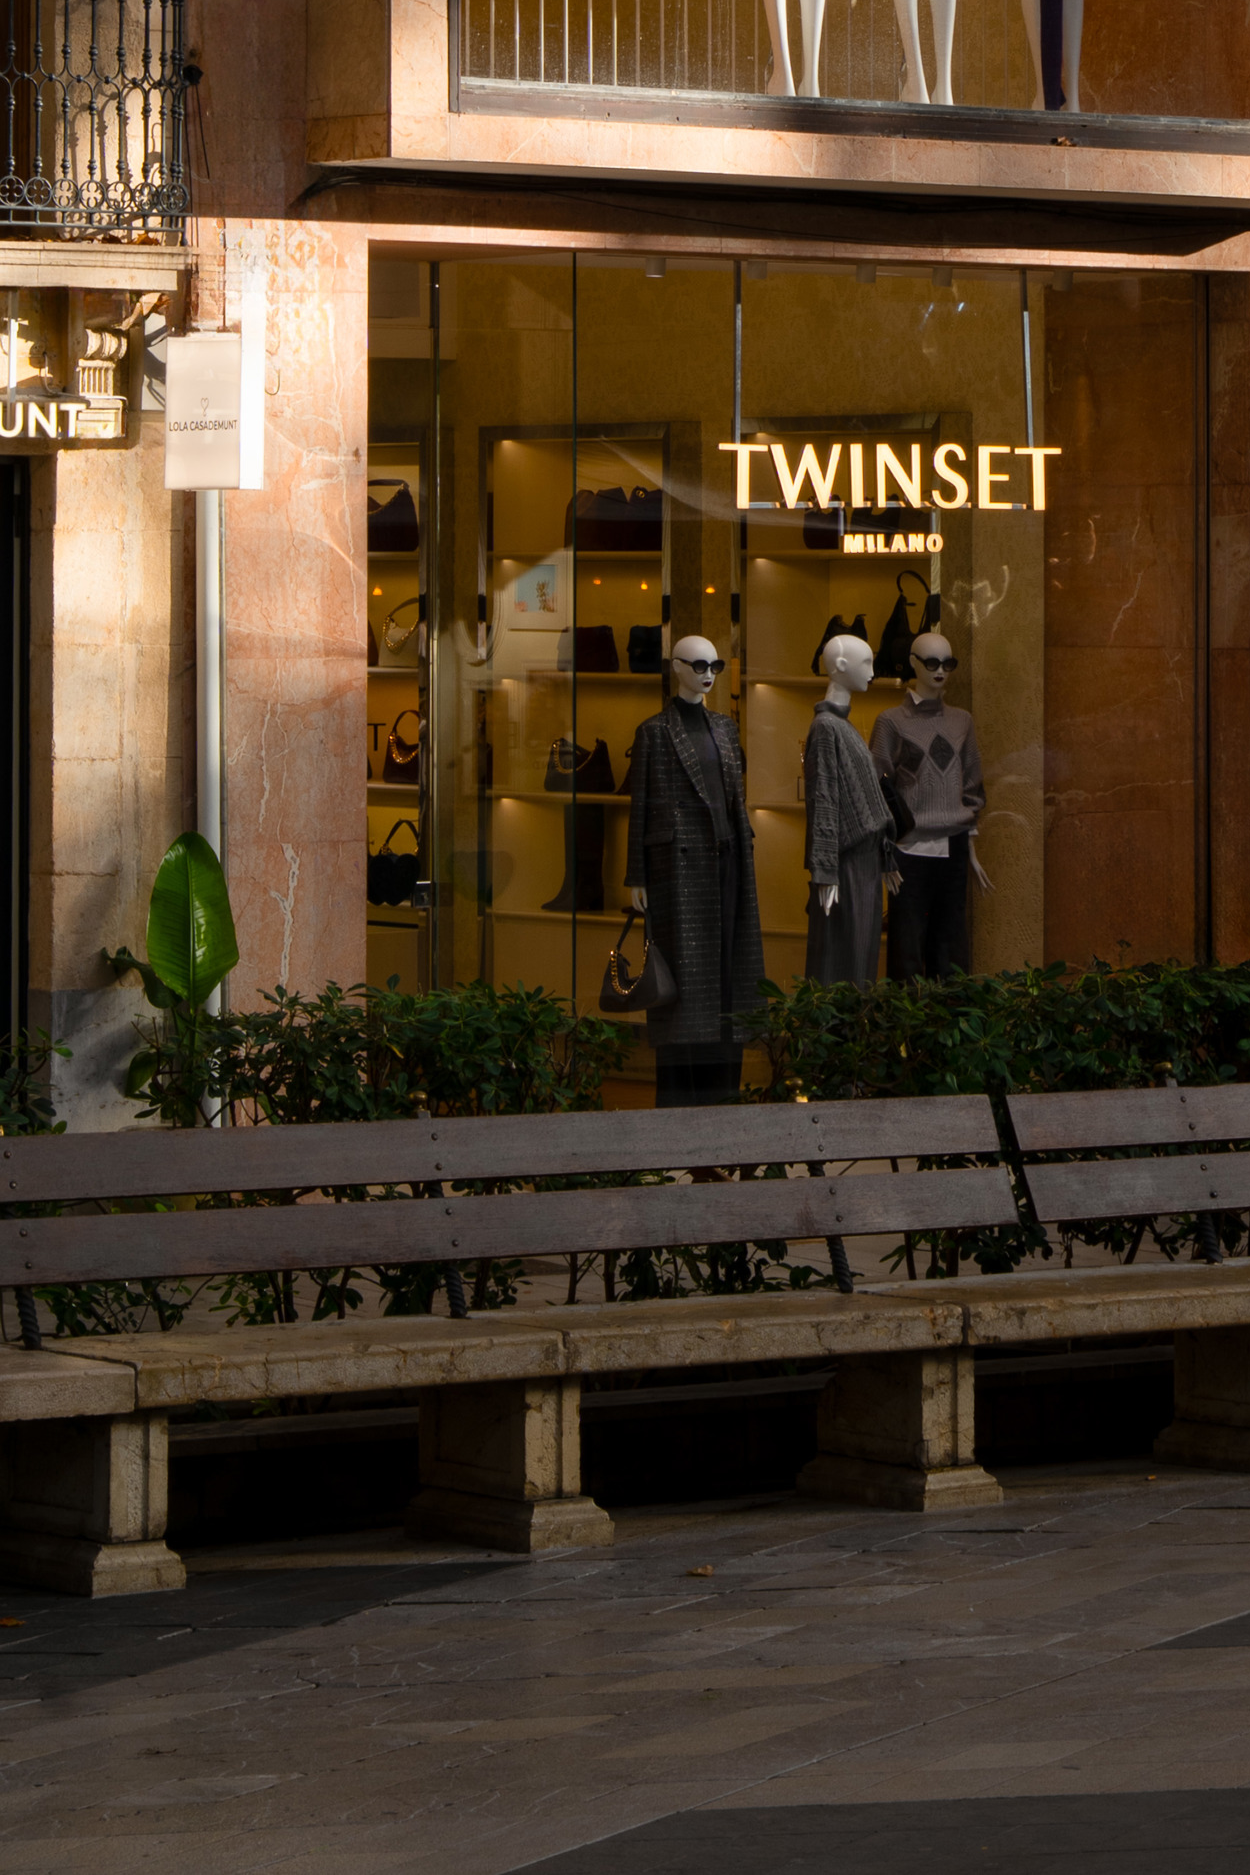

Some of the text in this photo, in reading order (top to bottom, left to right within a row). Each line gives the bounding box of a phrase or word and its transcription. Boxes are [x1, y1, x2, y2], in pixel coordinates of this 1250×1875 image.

[168, 420, 238, 432] LOLA CASADEMUNT
[718, 442, 1062, 511] TWINSET
[843, 533, 944, 553] MILANO
